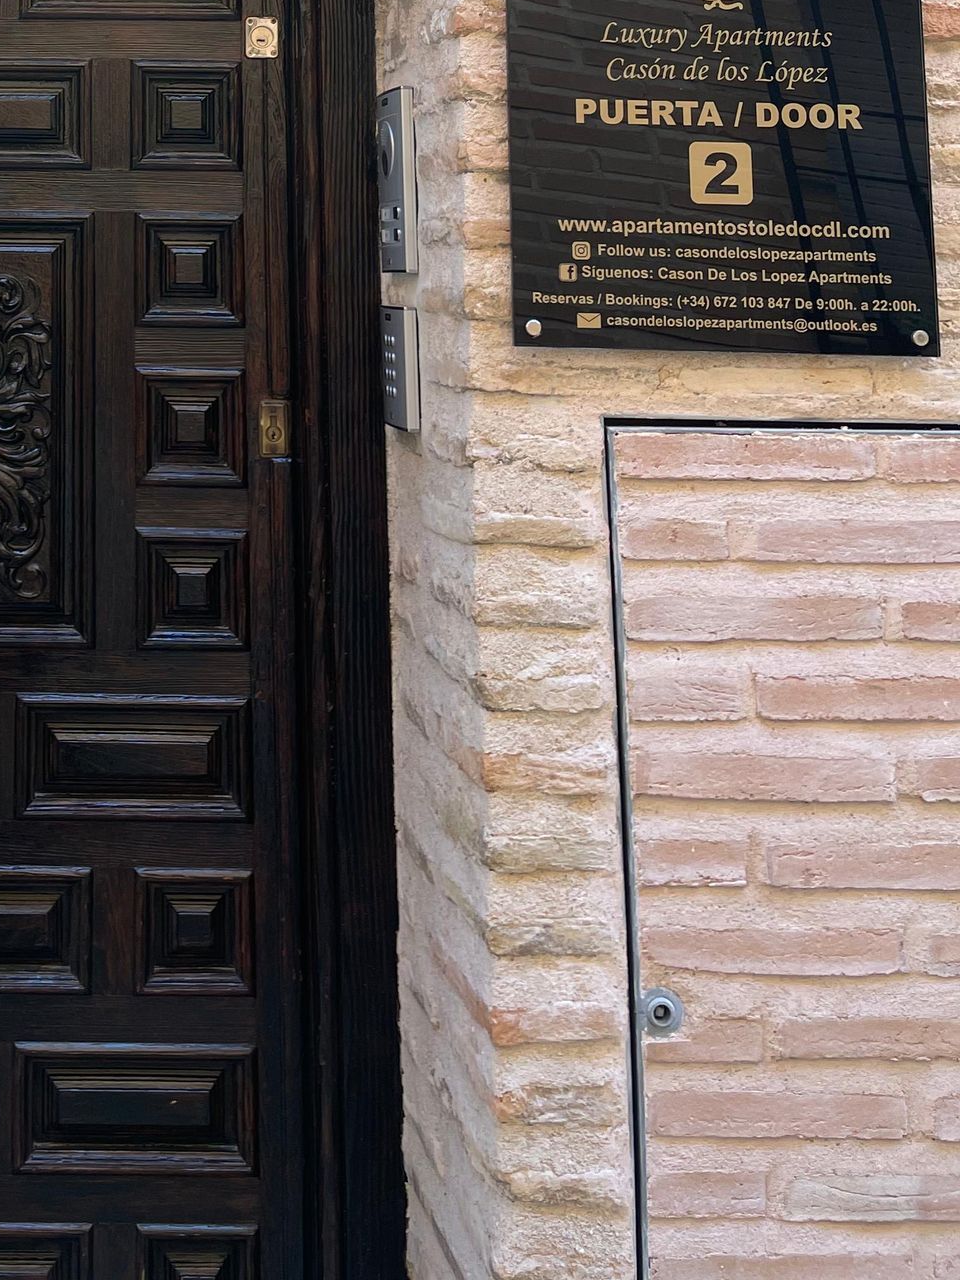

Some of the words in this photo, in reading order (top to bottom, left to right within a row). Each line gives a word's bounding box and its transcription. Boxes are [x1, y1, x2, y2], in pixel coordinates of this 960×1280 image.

[600, 21, 688, 52] Luxury
[691, 23, 833, 53] Apartments
[606, 57, 676, 81] Casón
[682, 56, 709, 81] de
[717, 57, 749, 81] los
[755, 60, 828, 90] López
[575, 98, 724, 127] PUERTA
[734, 101, 744, 128] /
[756, 102, 864, 130] DOOR
[704, 152, 740, 195] 2
[558, 218, 891, 240] www.apartamentostoledocdl.com
[597, 243, 645, 257] Follow
[649, 246, 671, 258] us:
[675, 246, 877, 263] casondeloslopezapartments
[581, 264, 654, 281] Síguenos:
[658, 267, 703, 280] Cason
[708, 268, 727, 281] De
[731, 269, 757, 281] Los
[762, 269, 805, 284] Lopez
[809, 270, 892, 285] Apartments
[532, 291, 594, 305] Reservas
[597, 293, 602, 305] /
[605, 293, 673, 308] Bookings:
[677, 295, 710, 310] (+34)
[713, 296, 737, 308] 672
[741, 296, 764, 309] 103
[767, 297, 791, 309] 847
[795, 298, 813, 310] De
[816, 298, 857, 311] 9:00h.
[861, 302, 869, 311] a
[872, 300, 921, 312] 22:00h.
[606, 315, 878, 333] casondeloslopezapartments@outlook.es
